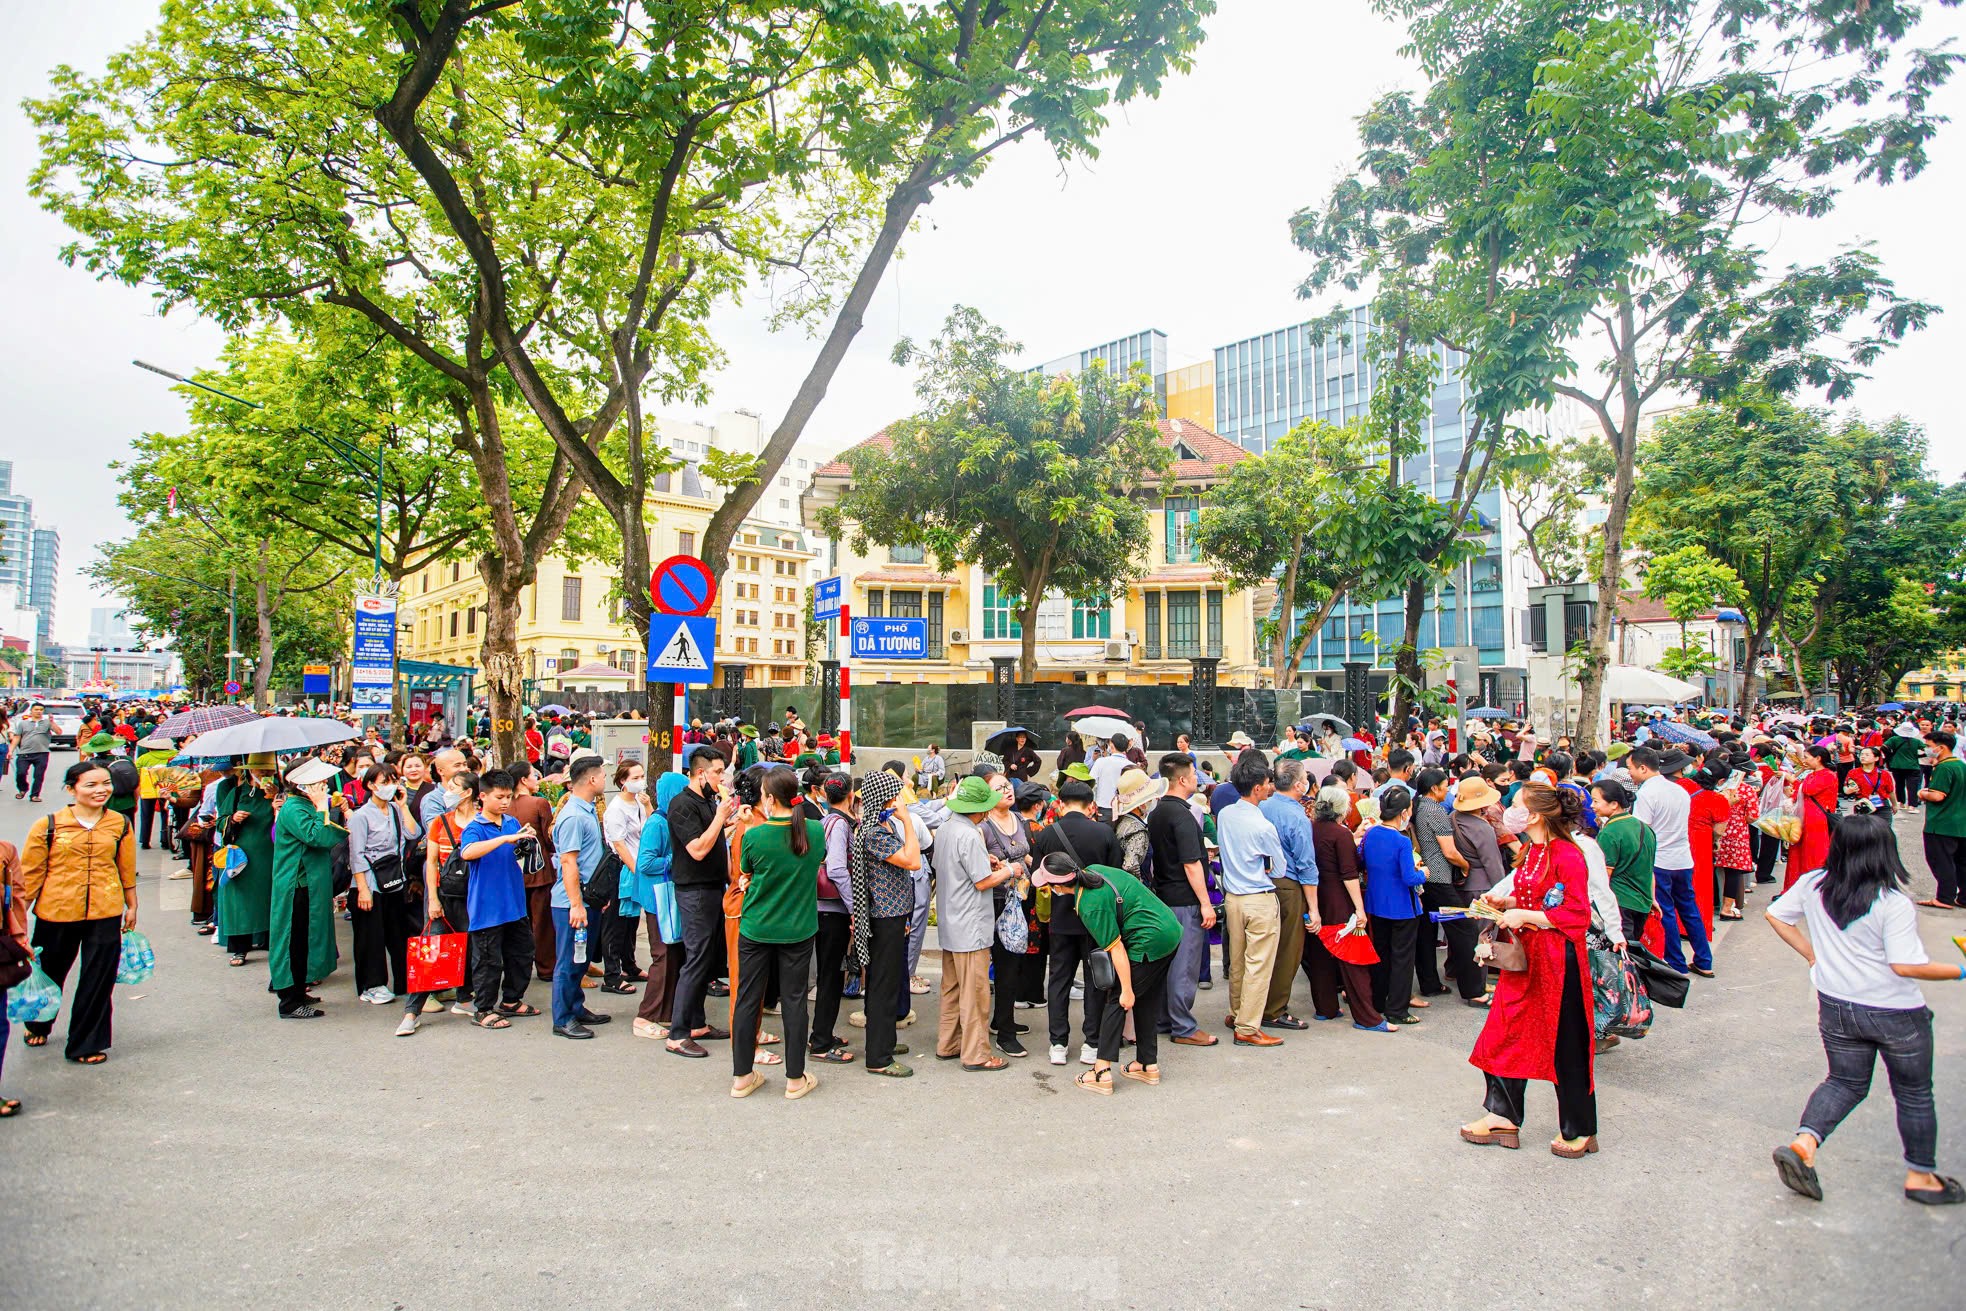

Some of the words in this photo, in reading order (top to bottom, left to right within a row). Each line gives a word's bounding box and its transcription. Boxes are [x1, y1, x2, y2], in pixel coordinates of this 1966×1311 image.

[884, 622, 908, 633] PHỐ
[858, 634, 876, 651] DÃ
[879, 636, 921, 653] TƯỢNG
